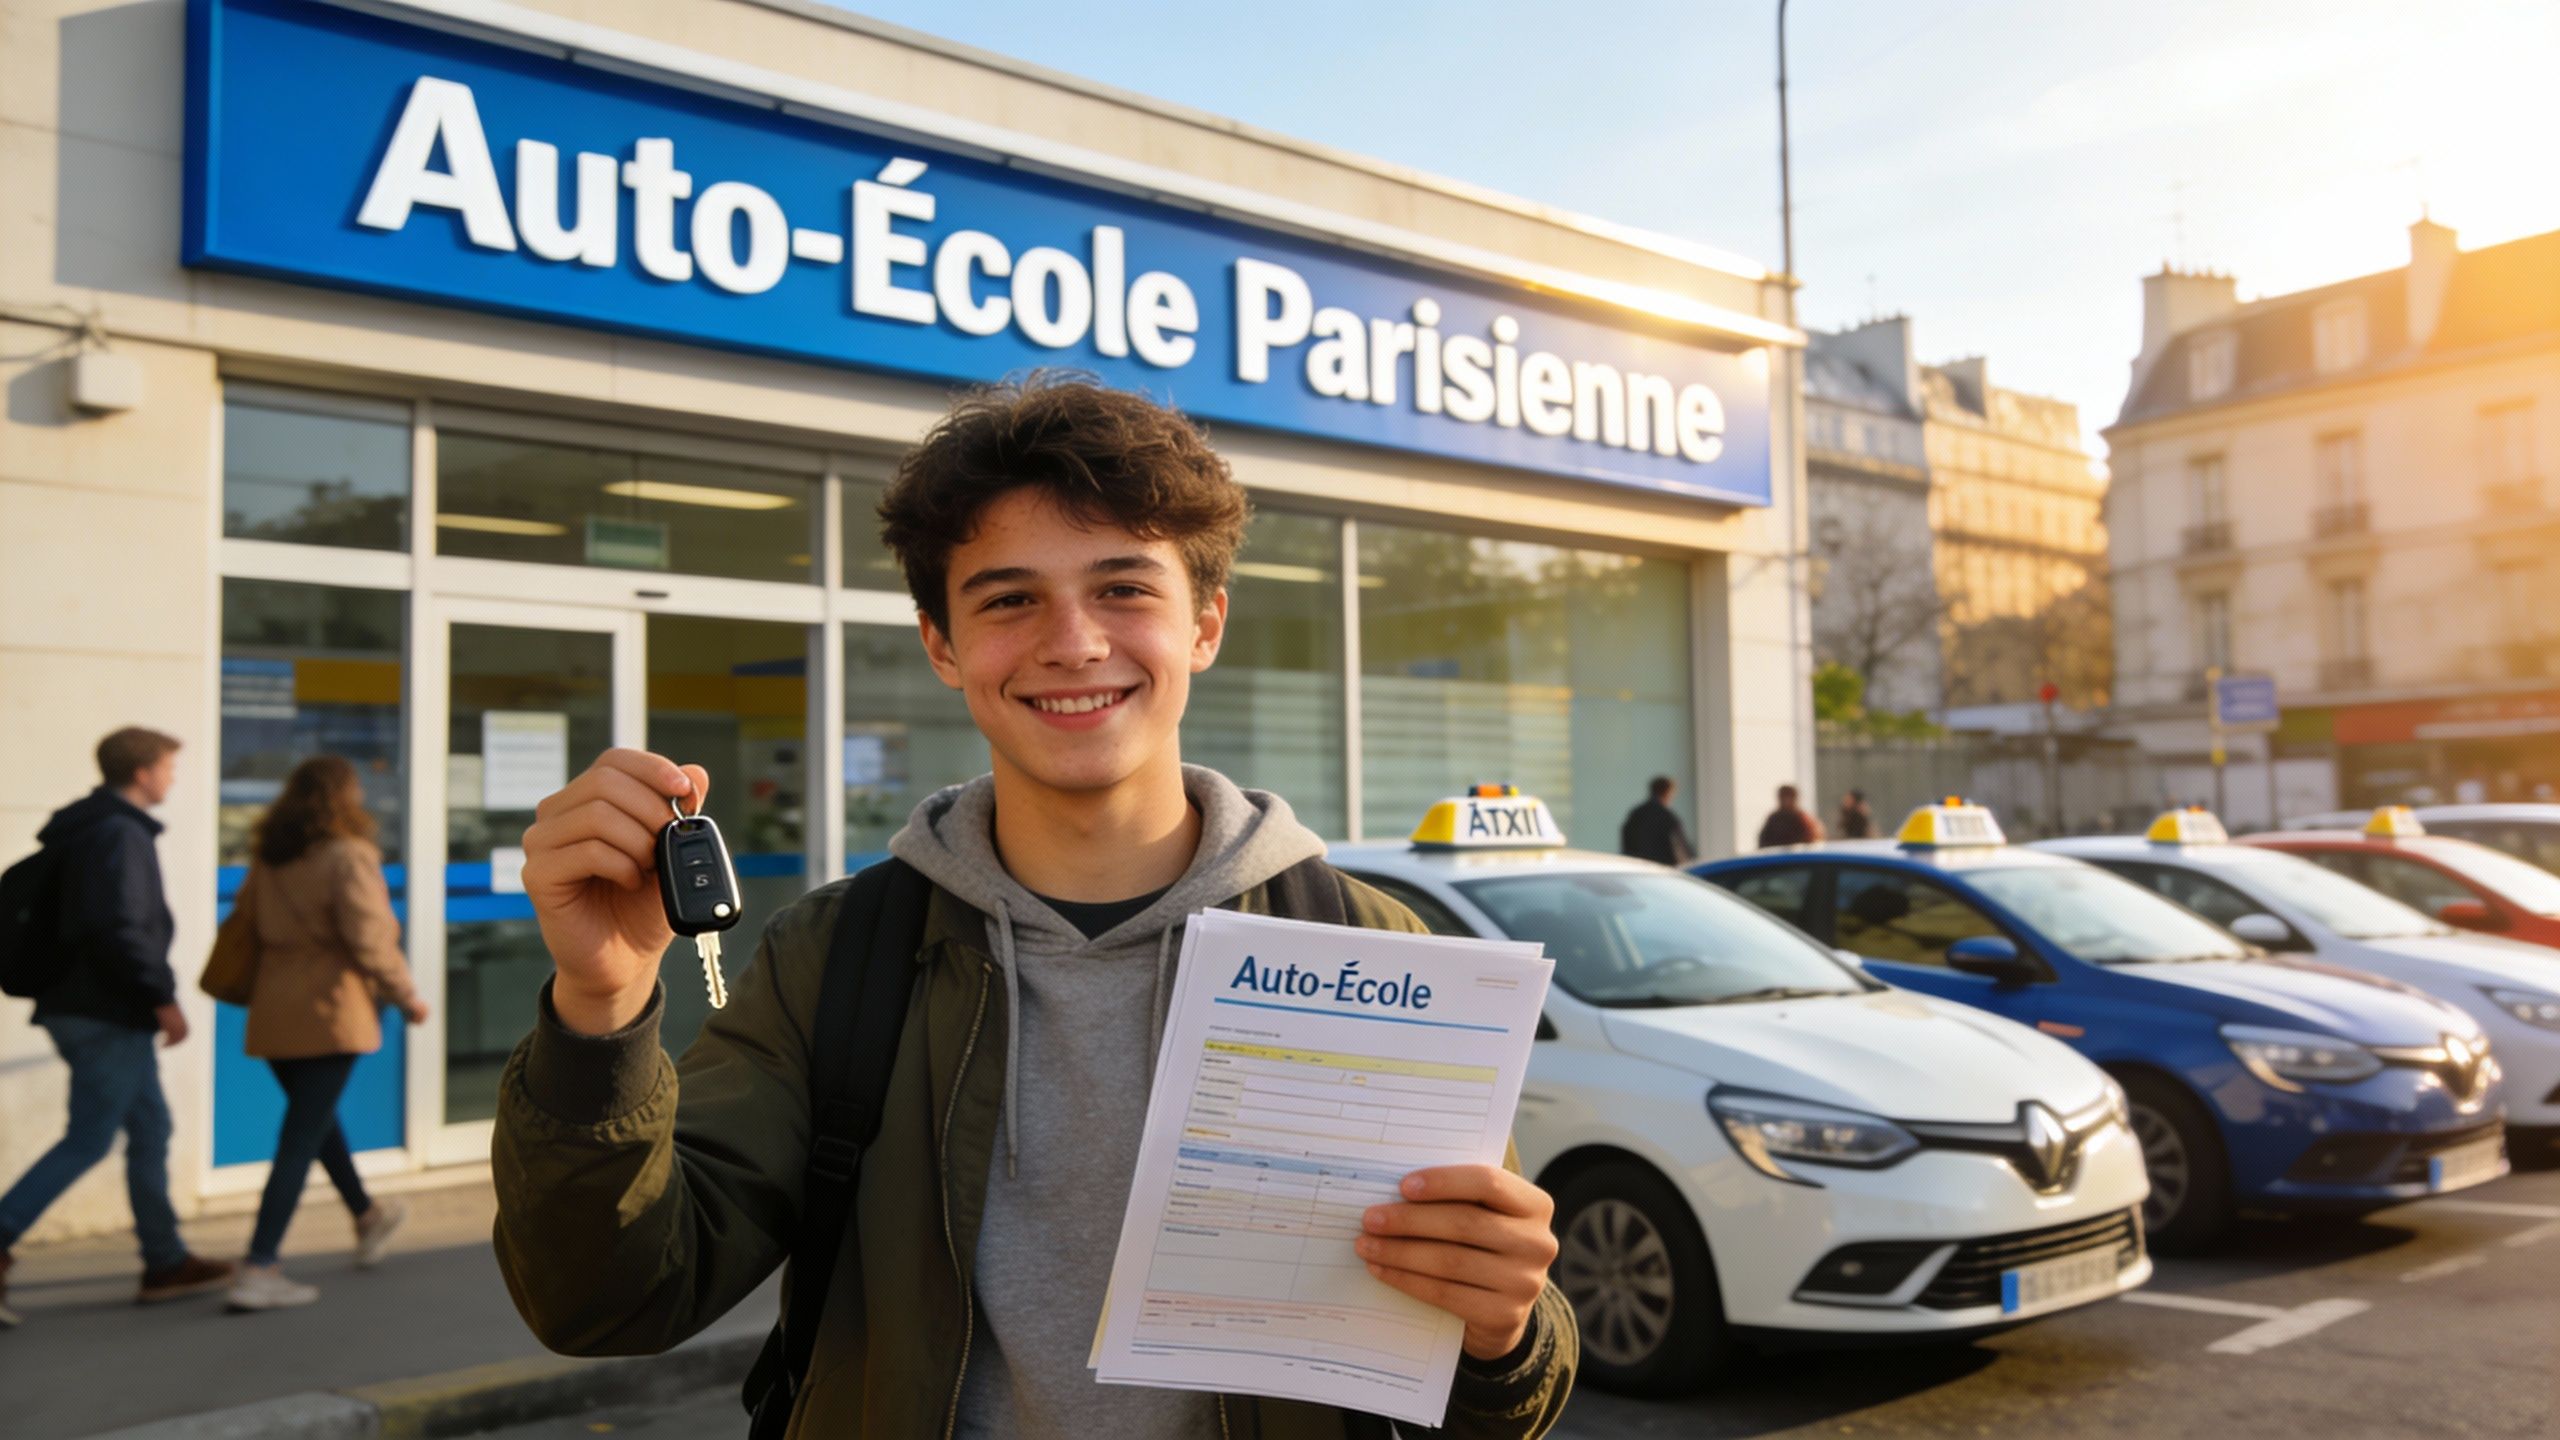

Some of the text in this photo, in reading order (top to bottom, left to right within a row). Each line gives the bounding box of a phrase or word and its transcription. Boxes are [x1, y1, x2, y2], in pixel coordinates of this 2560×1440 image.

[356, 74, 1726, 463] Auto-École Parisienne
[1230, 955, 1432, 1010] Auto-École
